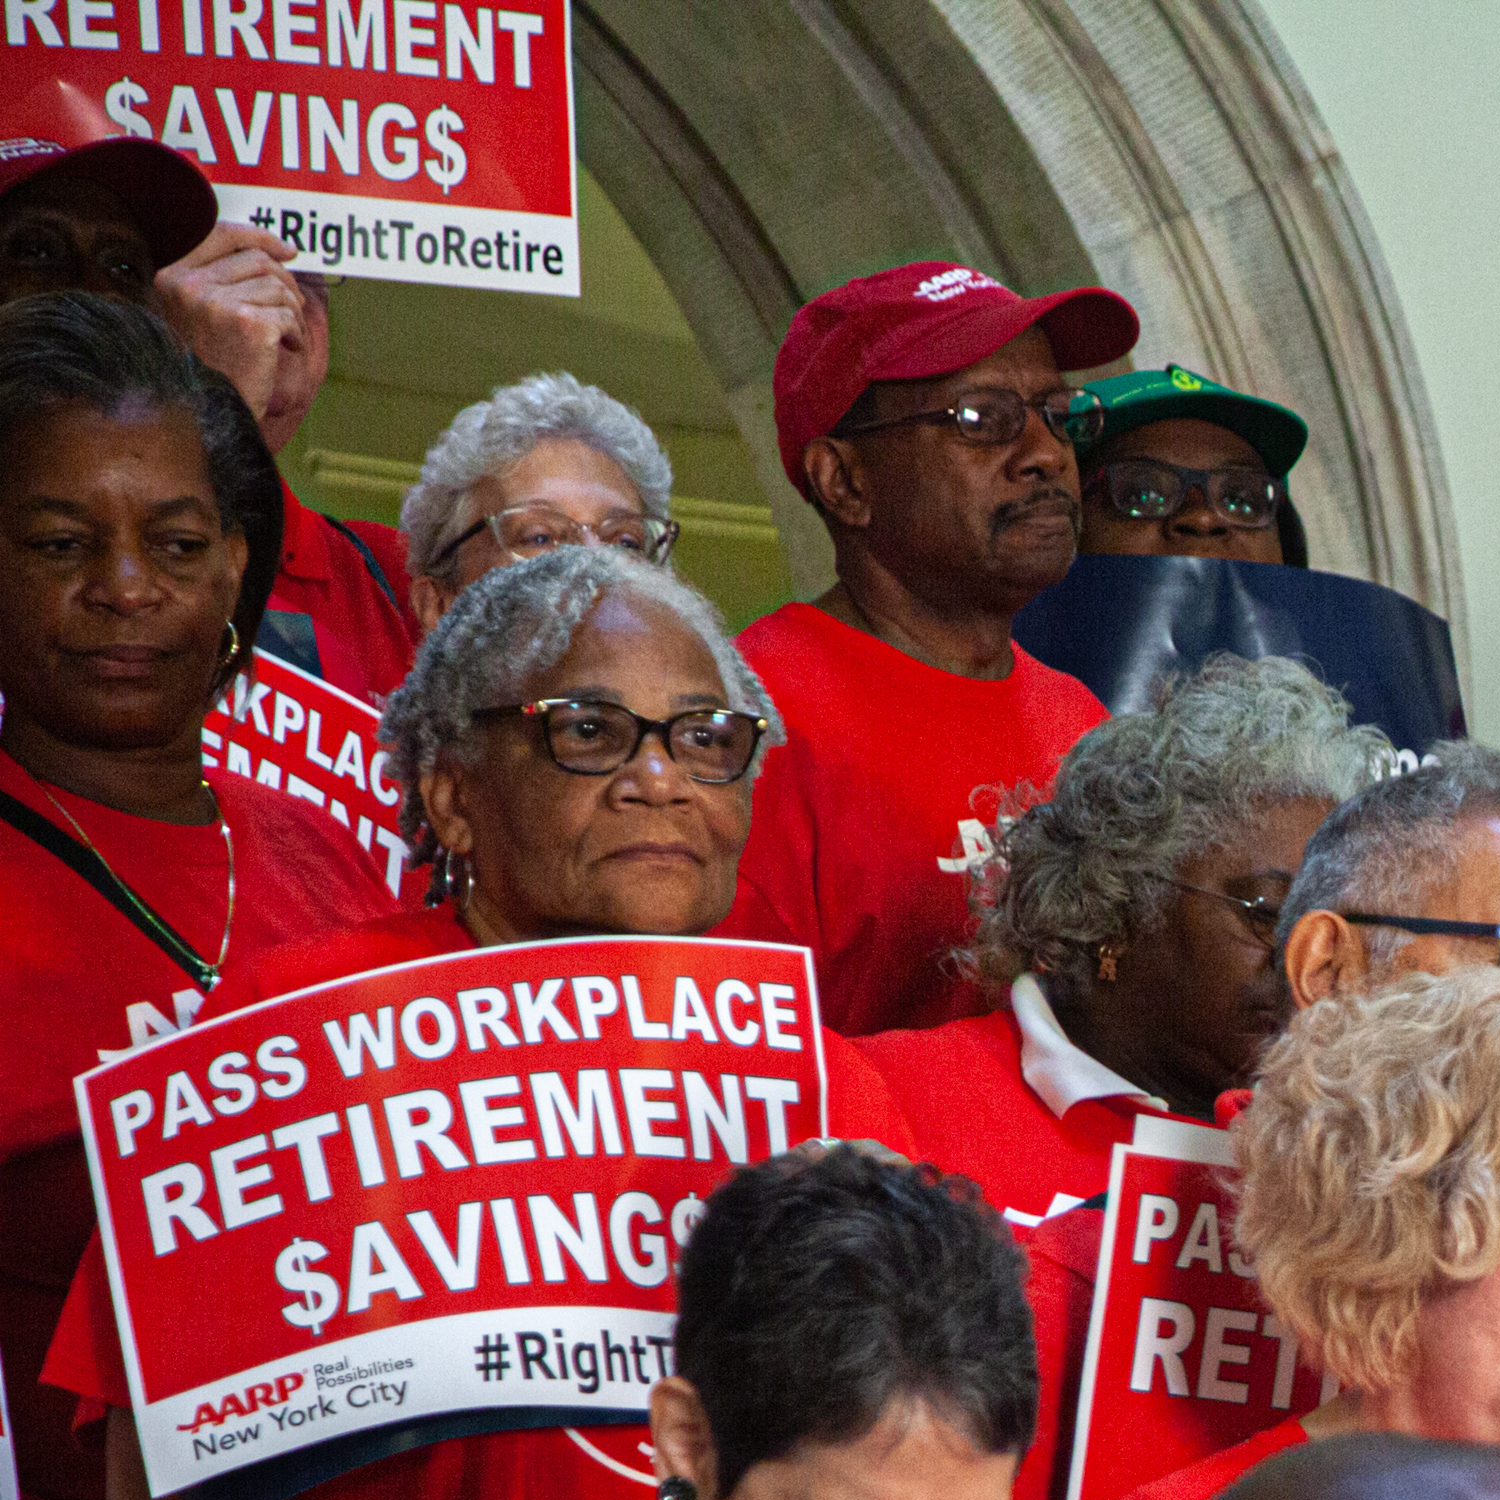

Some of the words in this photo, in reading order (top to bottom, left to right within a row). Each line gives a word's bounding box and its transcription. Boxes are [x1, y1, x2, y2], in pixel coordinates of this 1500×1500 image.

[4, 0, 544, 88] RETIREMENT
[104, 77, 468, 195] $AVING$
[249, 206, 564, 276] #RightToRetire
[110, 1034, 308, 1158] PASS
[322, 974, 802, 1078] WORKPLACE
[140, 1069, 801, 1257] RETIREMENT
[176, 1372, 305, 1434] AARP
[313, 1355, 349, 1378] Real
[316, 1357, 414, 1390] Possibilities
[192, 1423, 260, 1460] New
[268, 1395, 337, 1431] York
[346, 1380, 408, 1408] City
